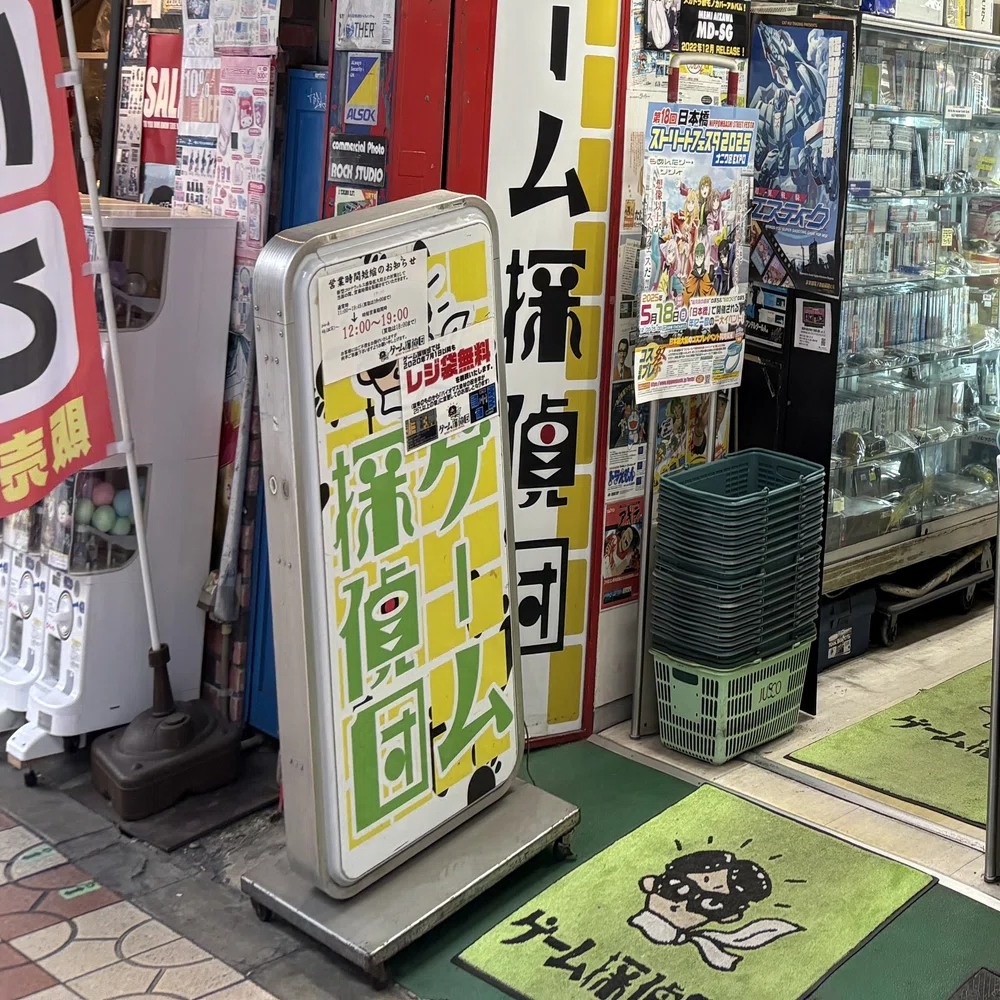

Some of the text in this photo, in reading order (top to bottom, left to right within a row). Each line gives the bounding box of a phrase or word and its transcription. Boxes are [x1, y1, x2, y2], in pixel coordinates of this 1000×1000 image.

[696, 20, 734, 42] MD-SG
[681, 41, 714, 55] 2022年12月
[143, 66, 179, 118] SAL
[346, 108, 376, 122] ALSOK
[653, 107, 677, 125] 第18回
[678, 109, 710, 127] 日本橋
[367, 141, 385, 156] Photo
[649, 127, 752, 152] ストリートフェスタ2025
[331, 163, 384, 183] ROCK STUDIO
[328, 256, 416, 290] 営業時間短縮のお知らせ
[640, 303, 679, 325] 5月18日
[406, 338, 491, 394] レジ袋無料
[418, 419, 514, 776] ゲーム
[331, 428, 431, 834] 探偵団
[758, 680, 782, 704] JUSCO
